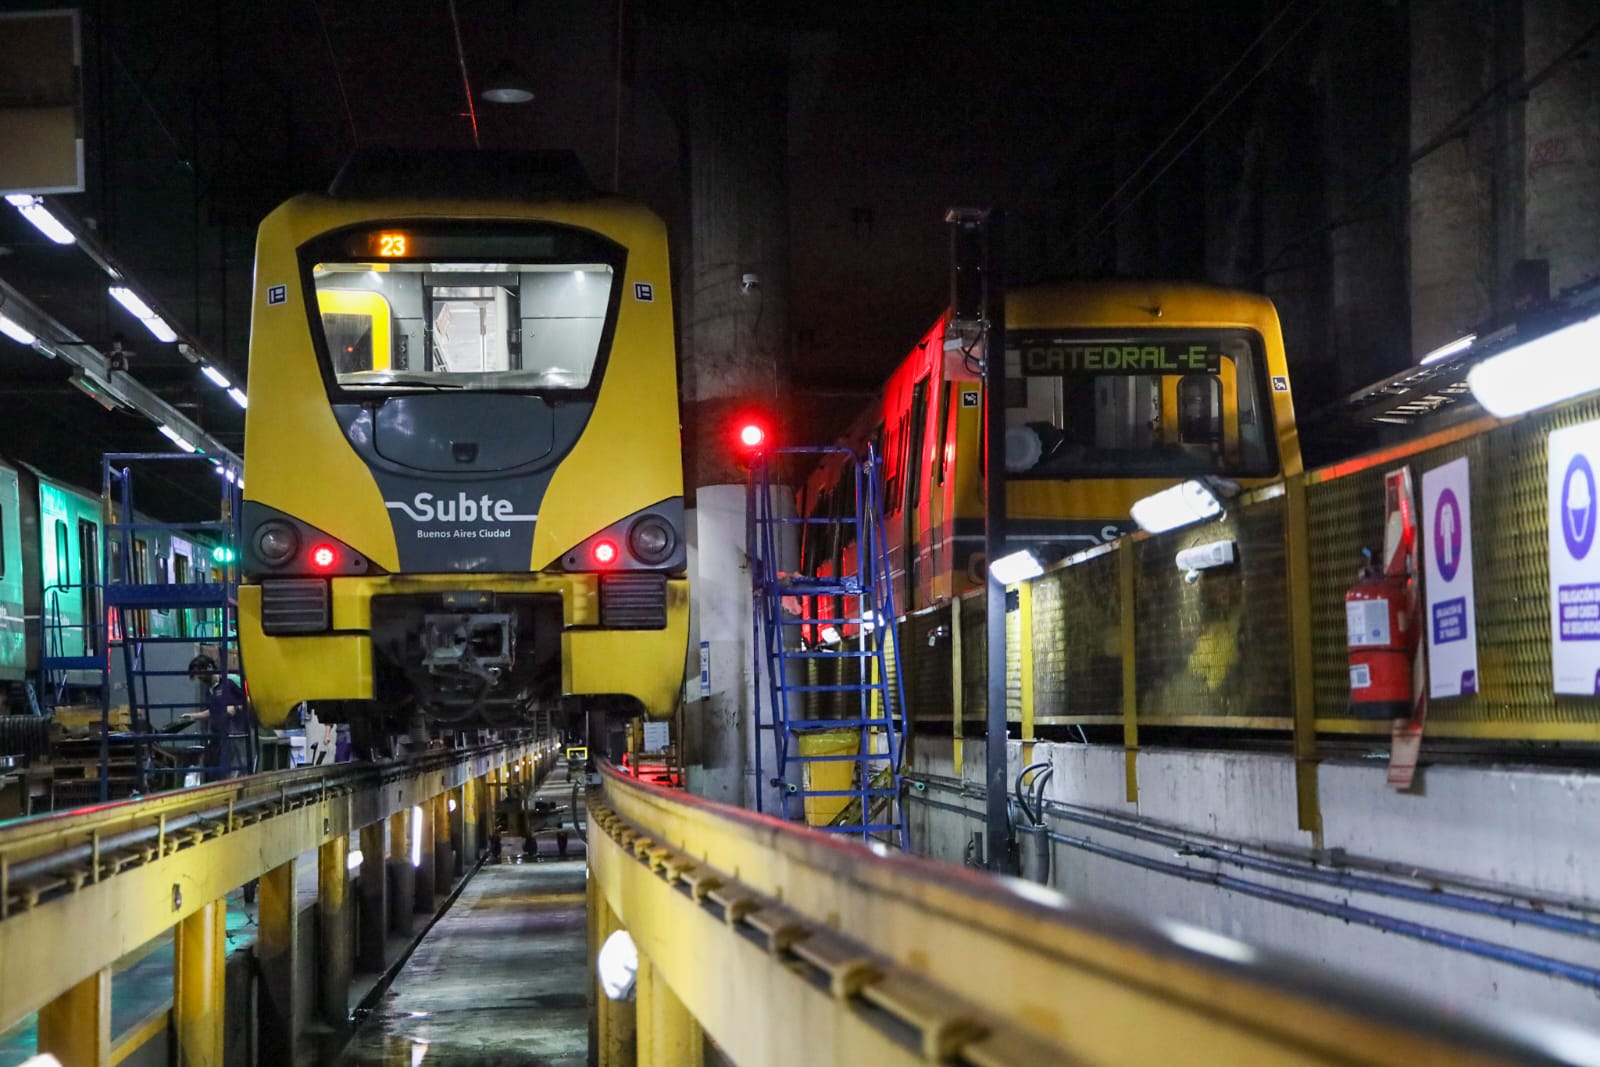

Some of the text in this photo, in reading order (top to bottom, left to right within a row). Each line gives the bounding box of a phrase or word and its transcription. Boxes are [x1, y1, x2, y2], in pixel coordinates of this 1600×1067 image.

[380, 235, 405, 256] 23
[414, 491, 514, 522] Subte
[417, 528, 511, 538] Buenos Aires Ciudad
